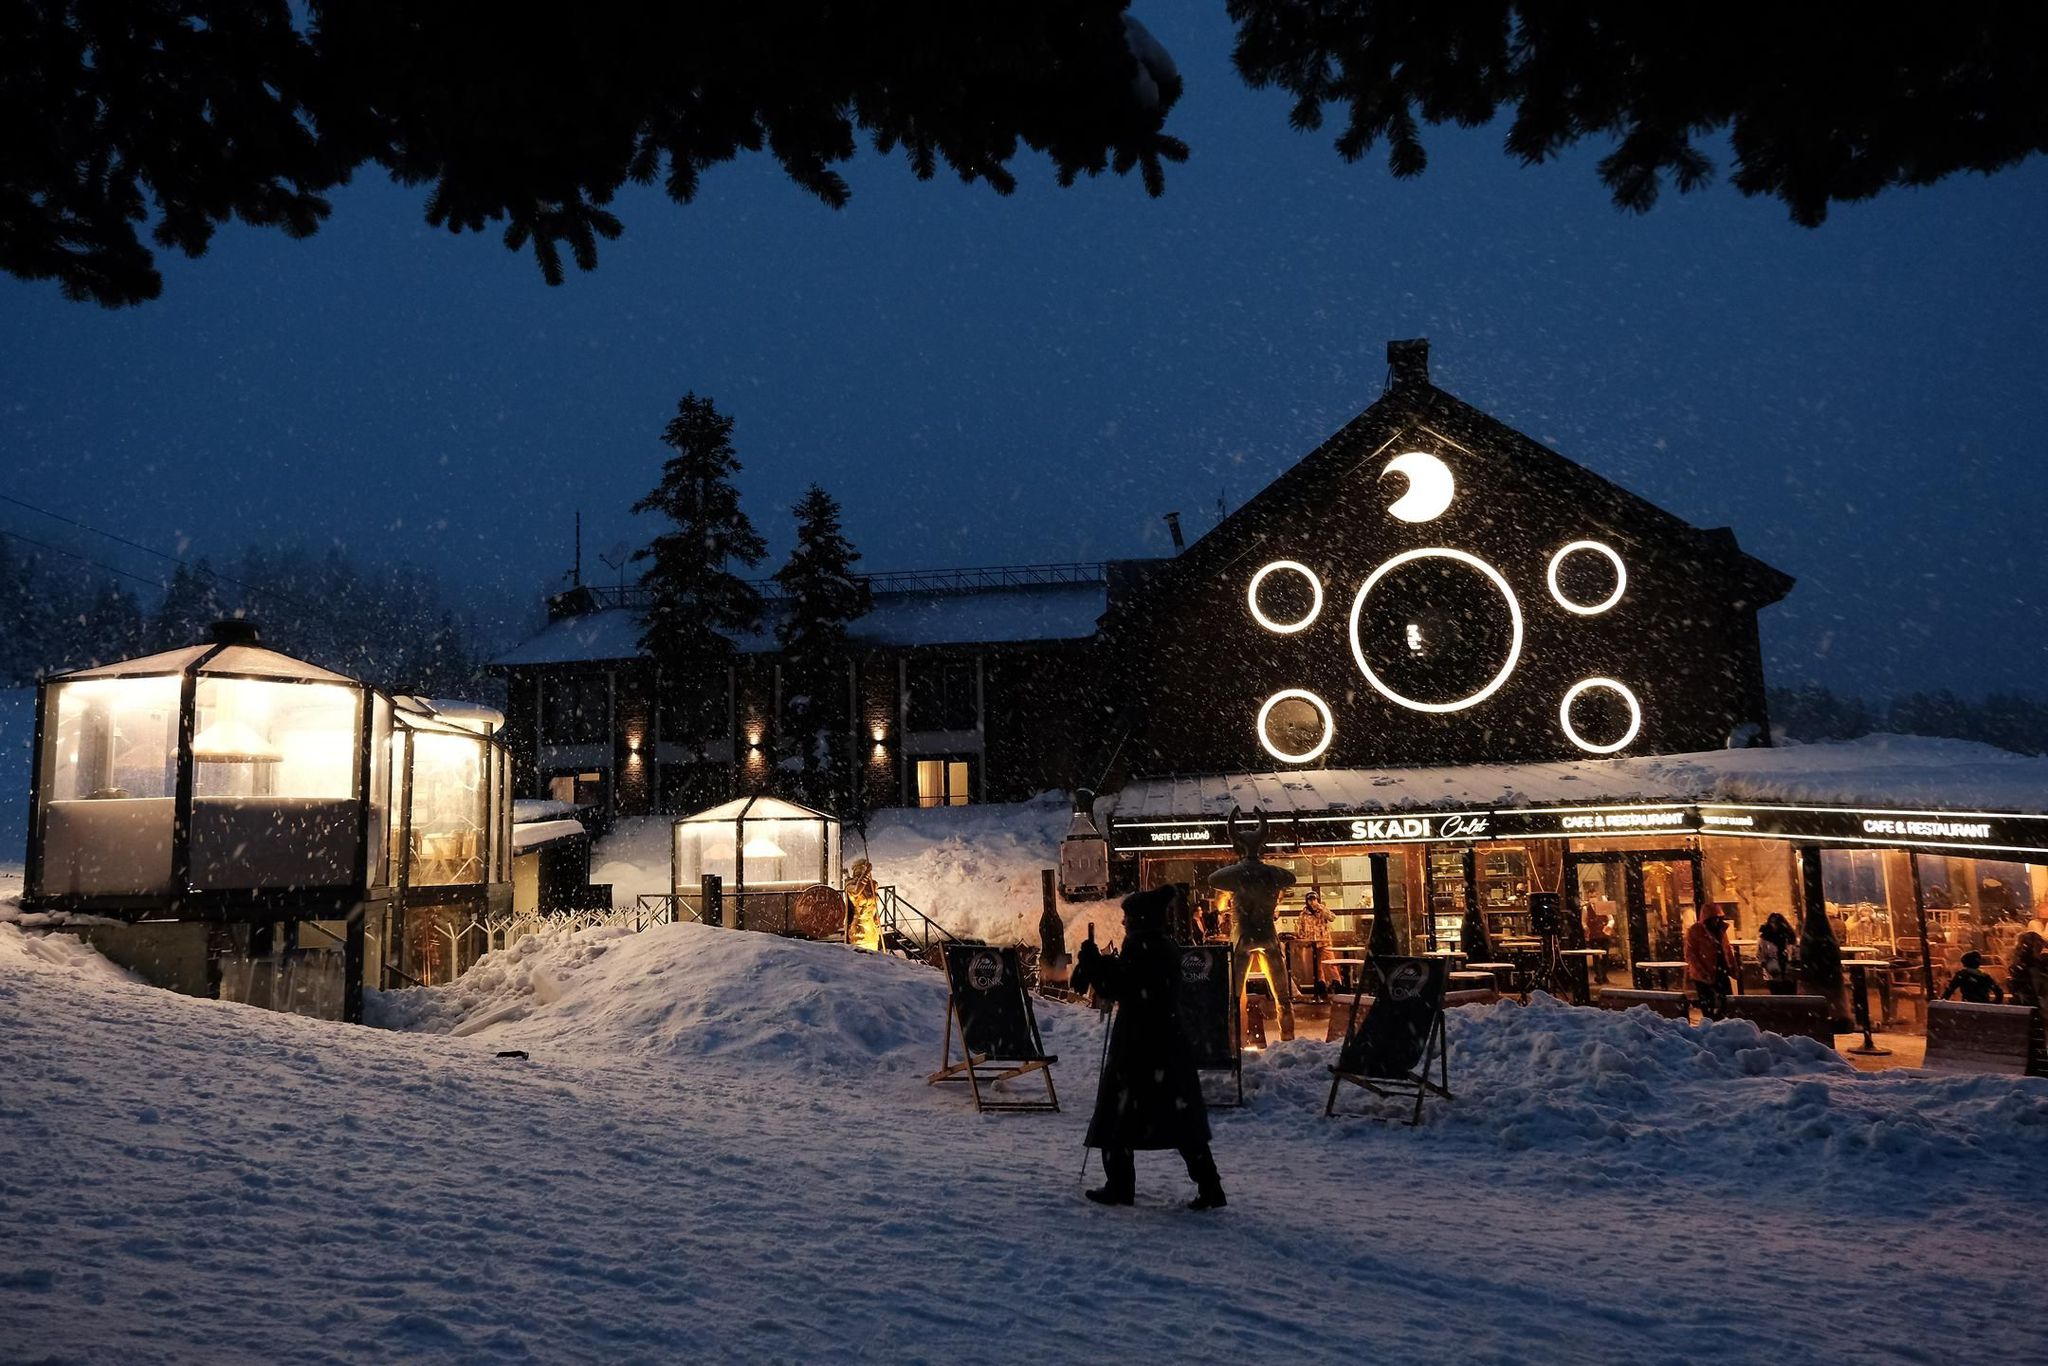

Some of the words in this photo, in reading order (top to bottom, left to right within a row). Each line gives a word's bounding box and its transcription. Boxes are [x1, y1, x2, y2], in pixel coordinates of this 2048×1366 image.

[1351, 818, 1431, 840] SKADI
[1440, 815, 1490, 838] Chalet
[1562, 815, 1594, 828] CAFE
[1595, 813, 1605, 827] &
[1606, 812, 1684, 827] RESTAURANT
[1863, 819, 1895, 833] CAFE
[1895, 821, 1906, 834] &
[1907, 821, 1991, 838] RESTAURANT
[1150, 833, 1171, 841] TASTE
[1172, 833, 1182, 841] OF
